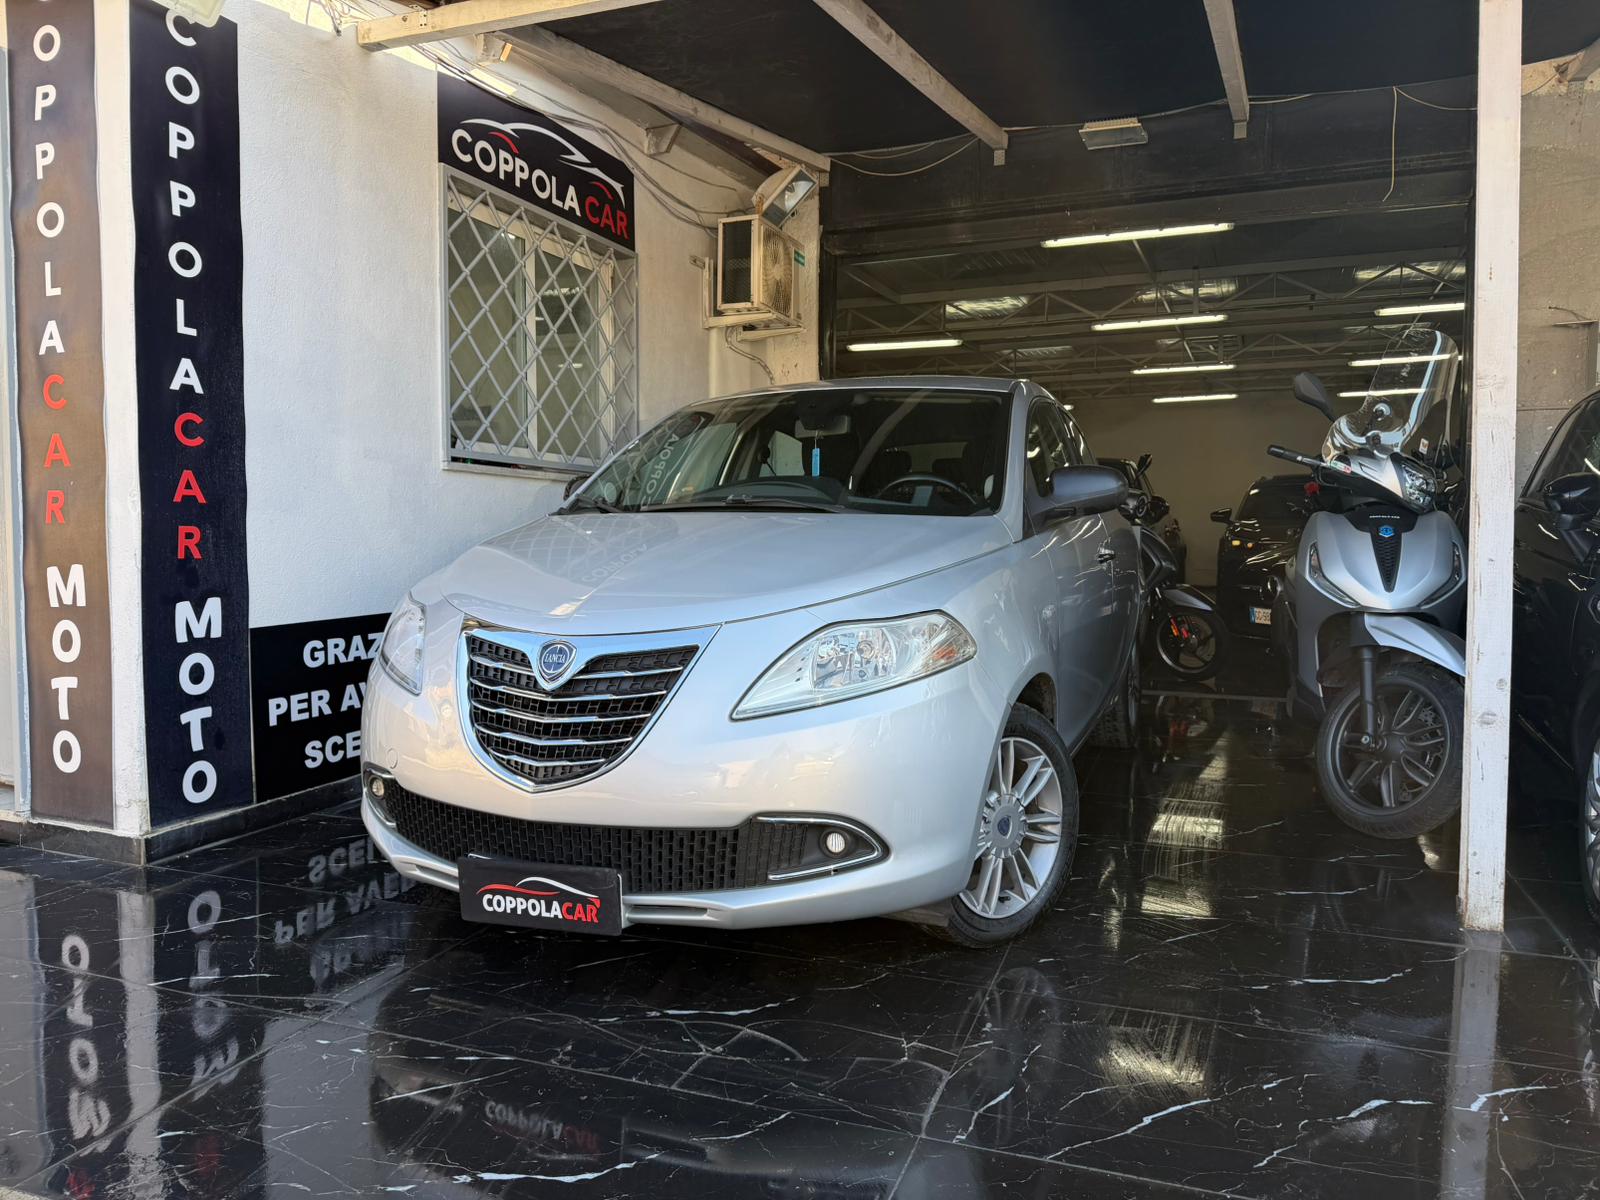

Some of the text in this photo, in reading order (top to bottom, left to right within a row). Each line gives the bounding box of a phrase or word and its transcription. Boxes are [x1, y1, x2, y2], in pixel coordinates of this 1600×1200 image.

[33, 0, 86, 774] OPPOLACAR MOTO
[174, 597, 223, 804] MOTO
[268, 689, 332, 727] PER
